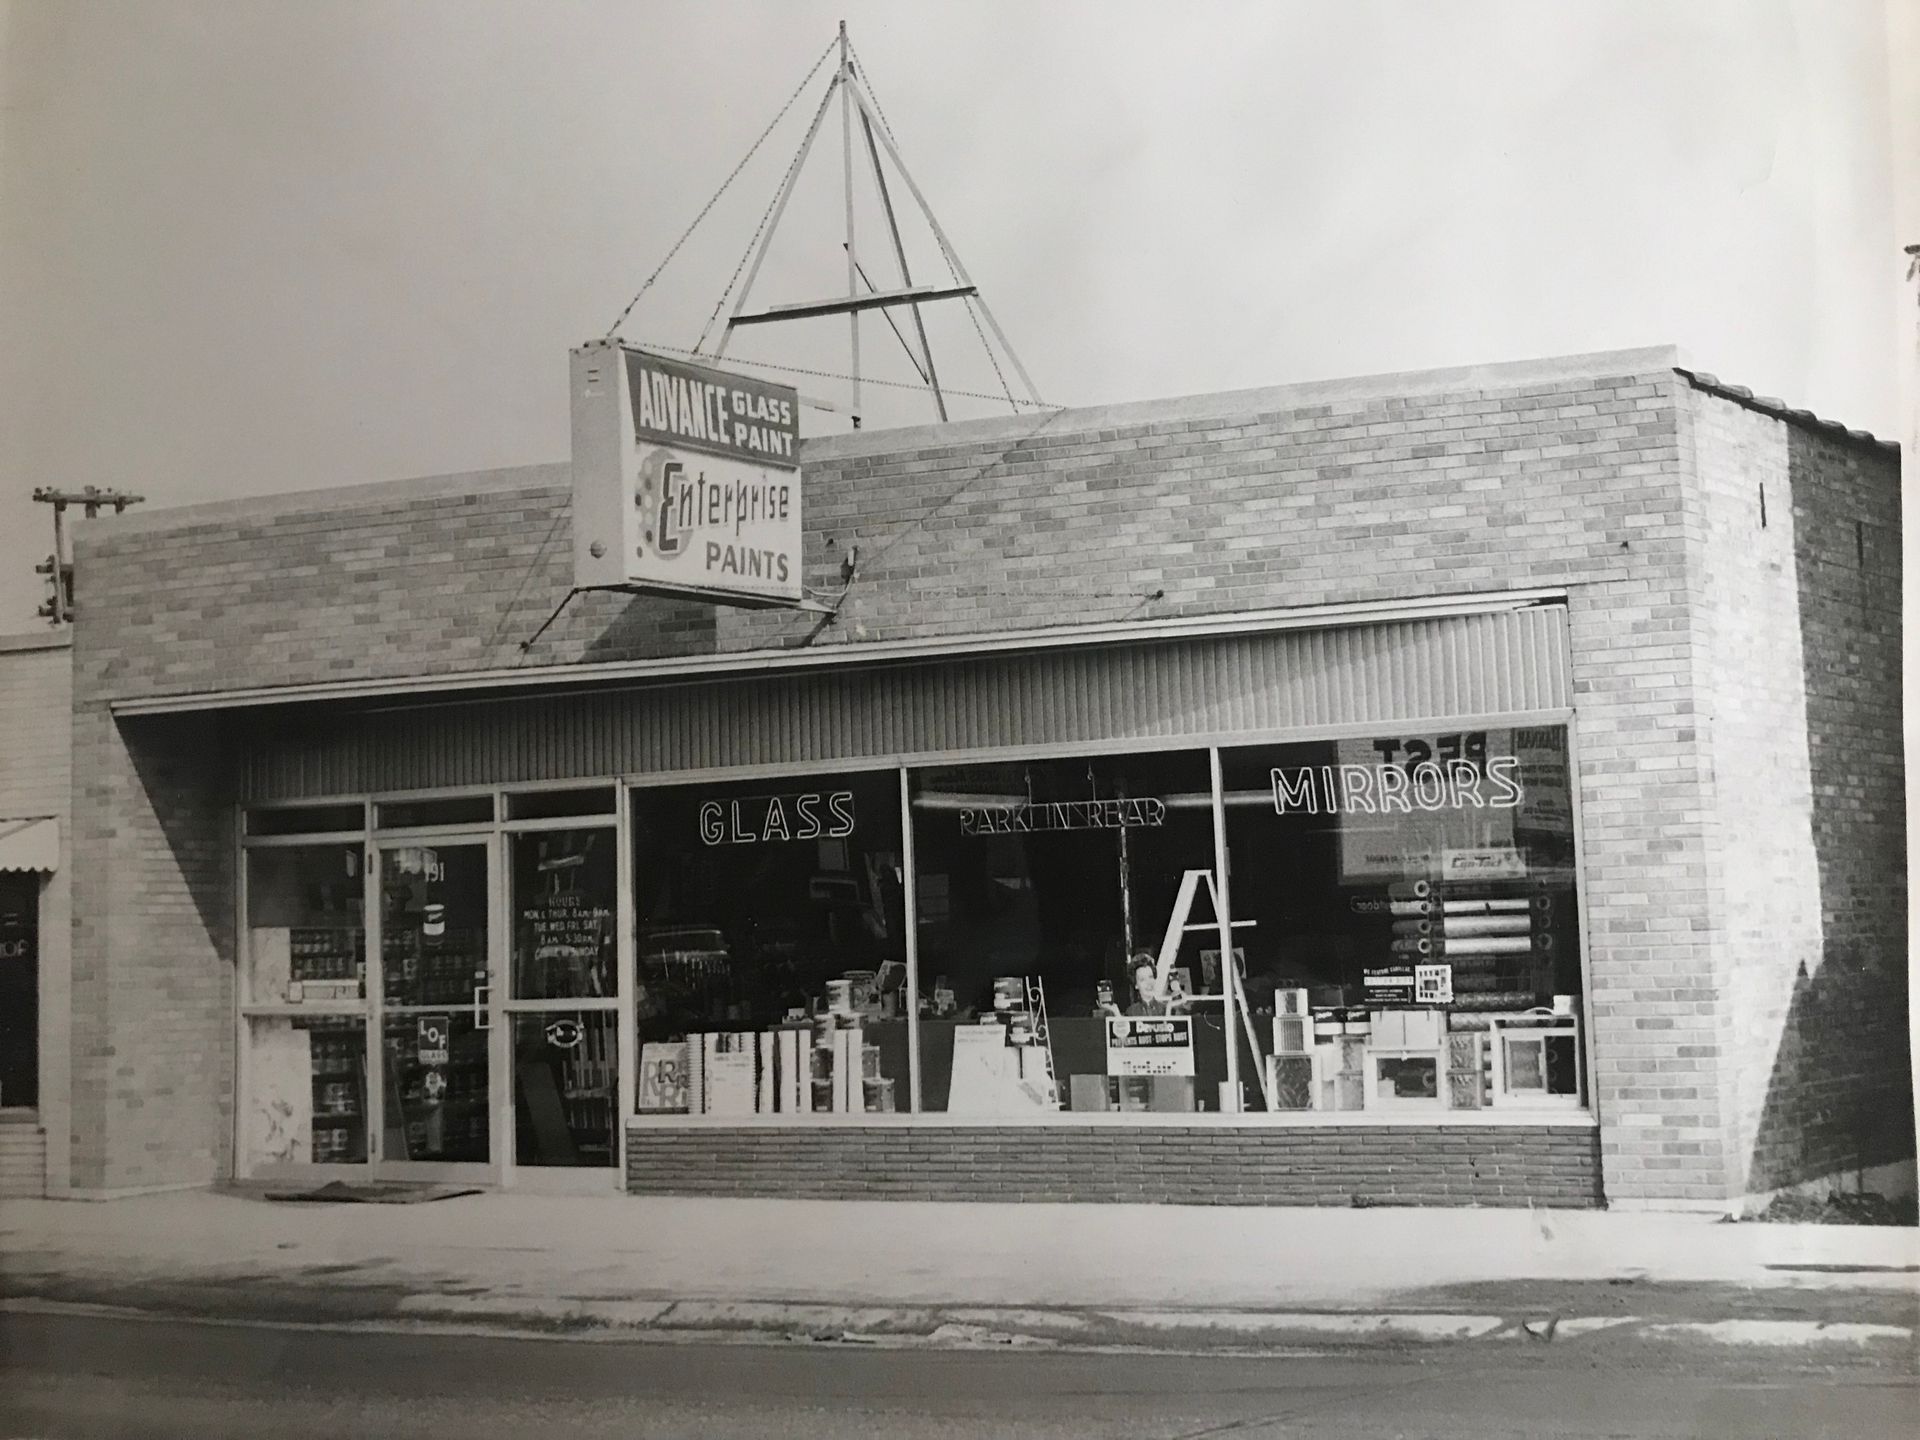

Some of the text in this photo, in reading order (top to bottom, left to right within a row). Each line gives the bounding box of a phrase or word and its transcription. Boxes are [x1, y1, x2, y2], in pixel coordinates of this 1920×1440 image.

[640, 368, 730, 444] ADVANCE
[731, 390, 791, 425] GLASS
[734, 422, 793, 456] PAINT
[658, 462, 789, 551] Enterprise
[706, 541, 789, 582] PAINTS
[1270, 755, 1524, 815] MIRRORS
[699, 791, 855, 845] GLASS
[960, 804, 1030, 835] PARK
[420, 1019, 446, 1049] LOF
